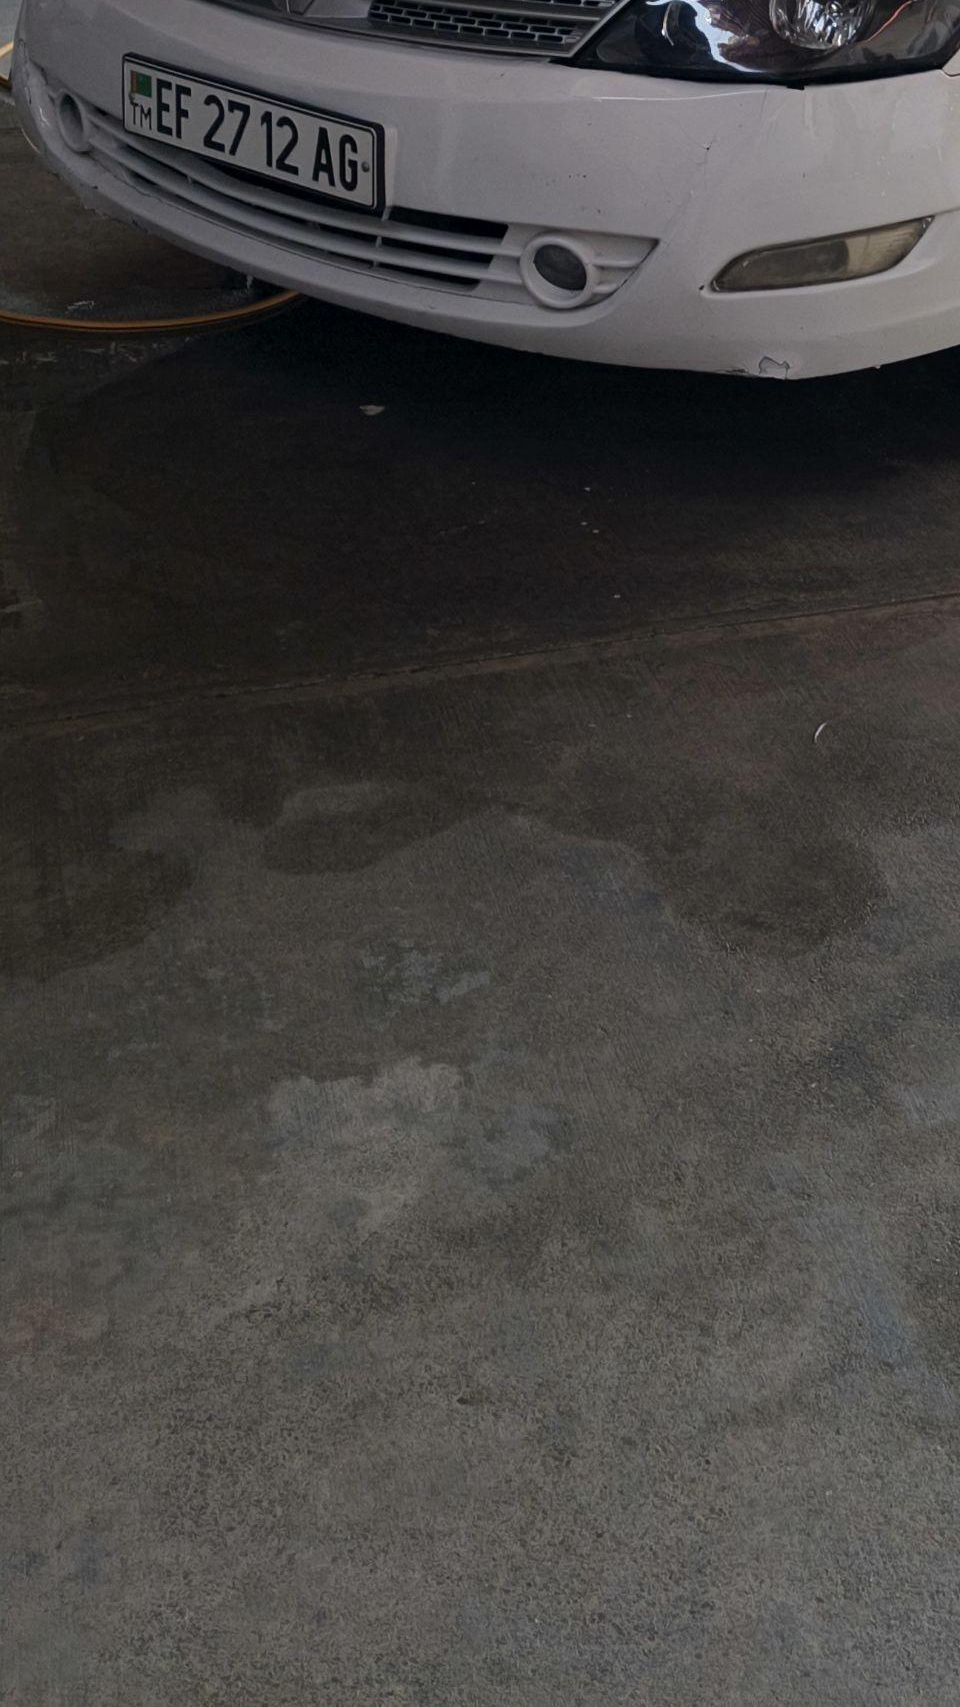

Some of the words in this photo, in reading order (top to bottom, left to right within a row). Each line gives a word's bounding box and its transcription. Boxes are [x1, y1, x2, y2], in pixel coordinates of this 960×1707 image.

[130, 101, 152, 130] TM
[156, 78, 192, 139] EF
[312, 126, 358, 192] AG
